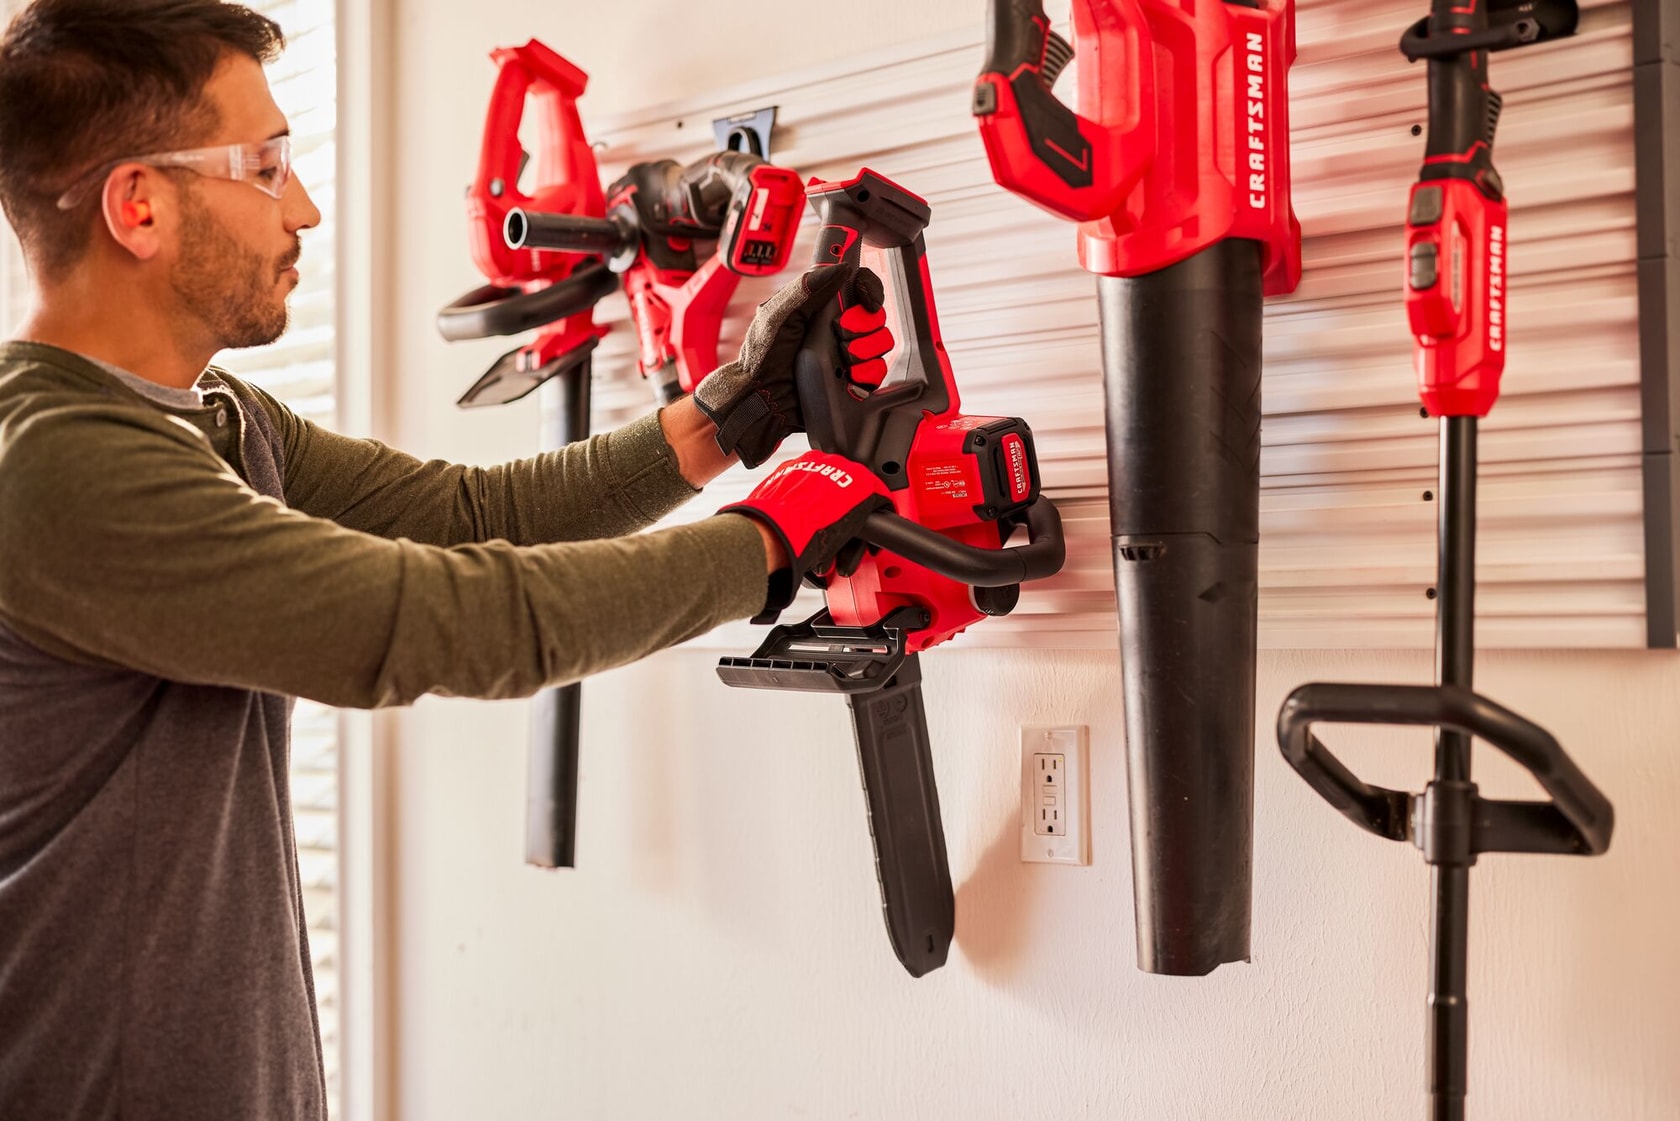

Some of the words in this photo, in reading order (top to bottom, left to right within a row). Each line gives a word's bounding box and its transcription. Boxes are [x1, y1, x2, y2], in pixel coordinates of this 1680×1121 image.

[1246, 32, 1266, 209] CRAFTSMAN
[1489, 225, 1504, 352] CRAFTSMAN
[1009, 441, 1023, 494] CRAFTSMAN
